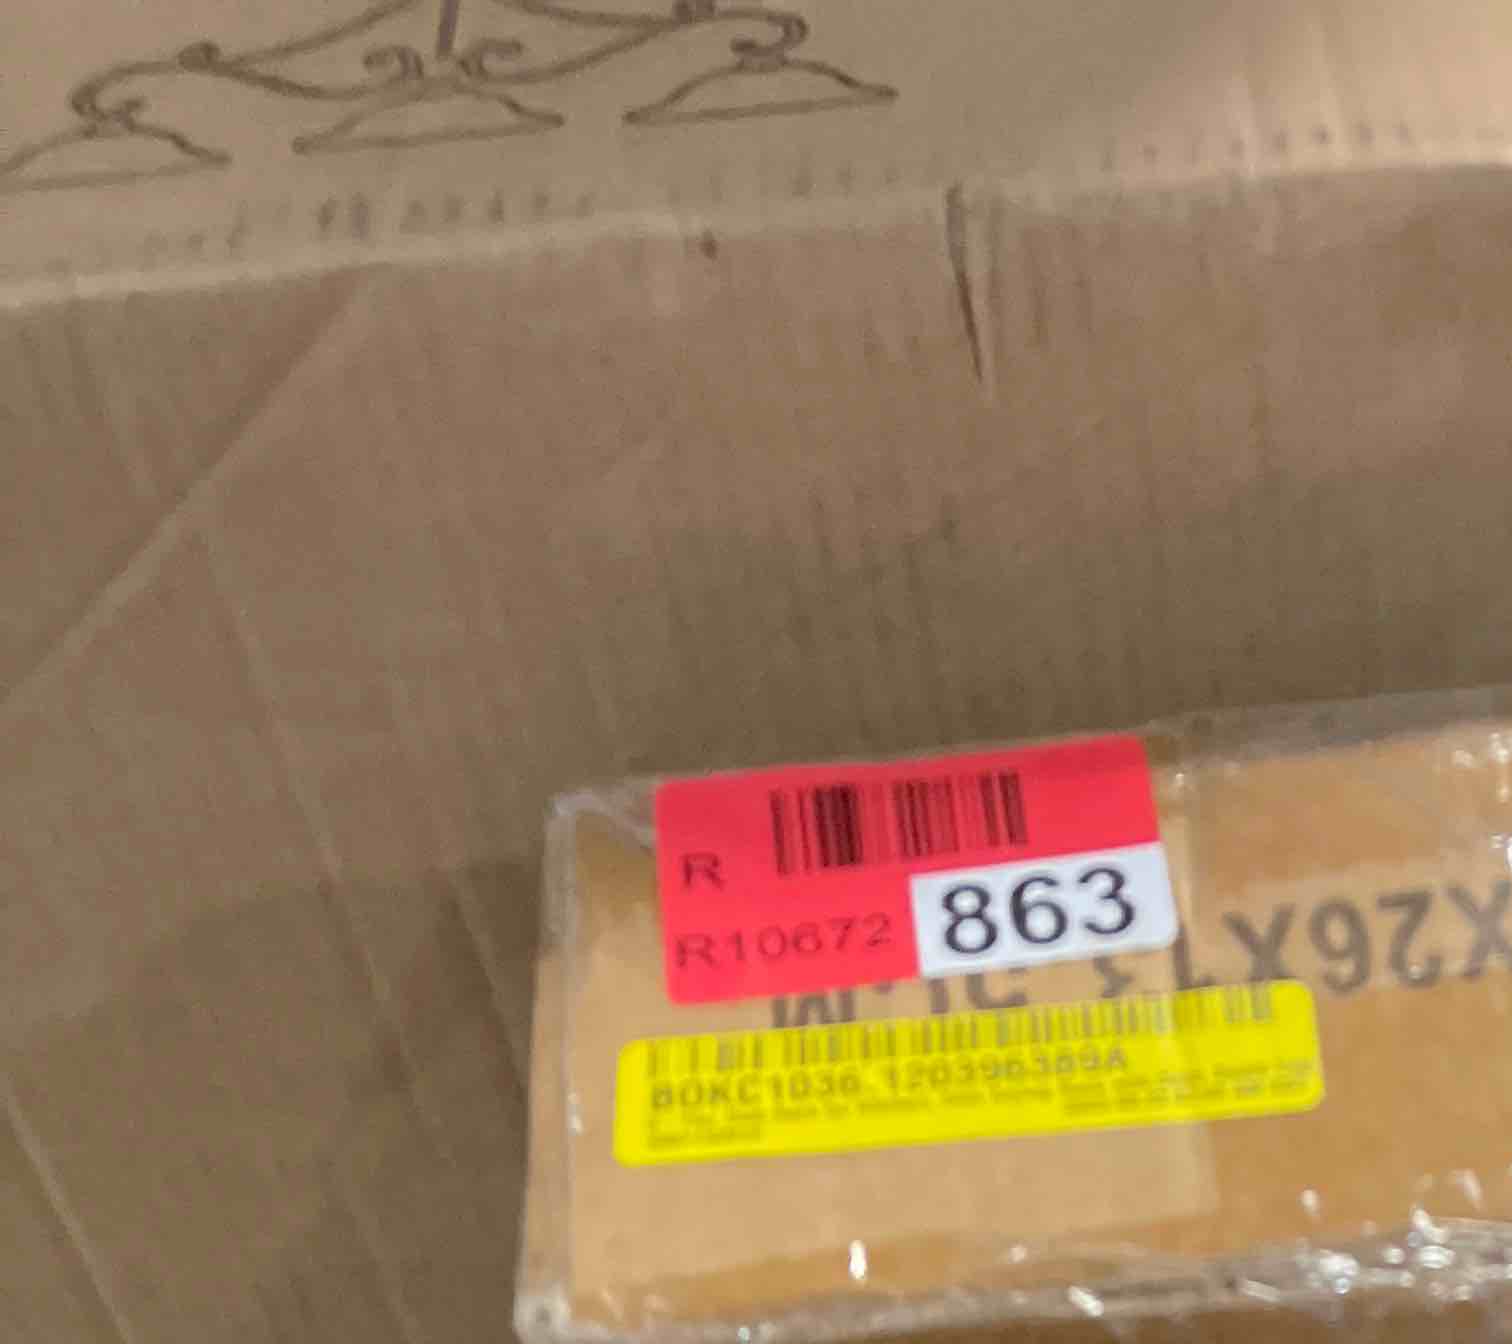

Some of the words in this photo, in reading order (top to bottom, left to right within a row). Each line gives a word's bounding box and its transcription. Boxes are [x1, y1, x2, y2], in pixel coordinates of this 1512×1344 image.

[682, 851, 723, 889] R
[941, 866, 1137, 956] 863
[674, 912, 893, 971] R10672
